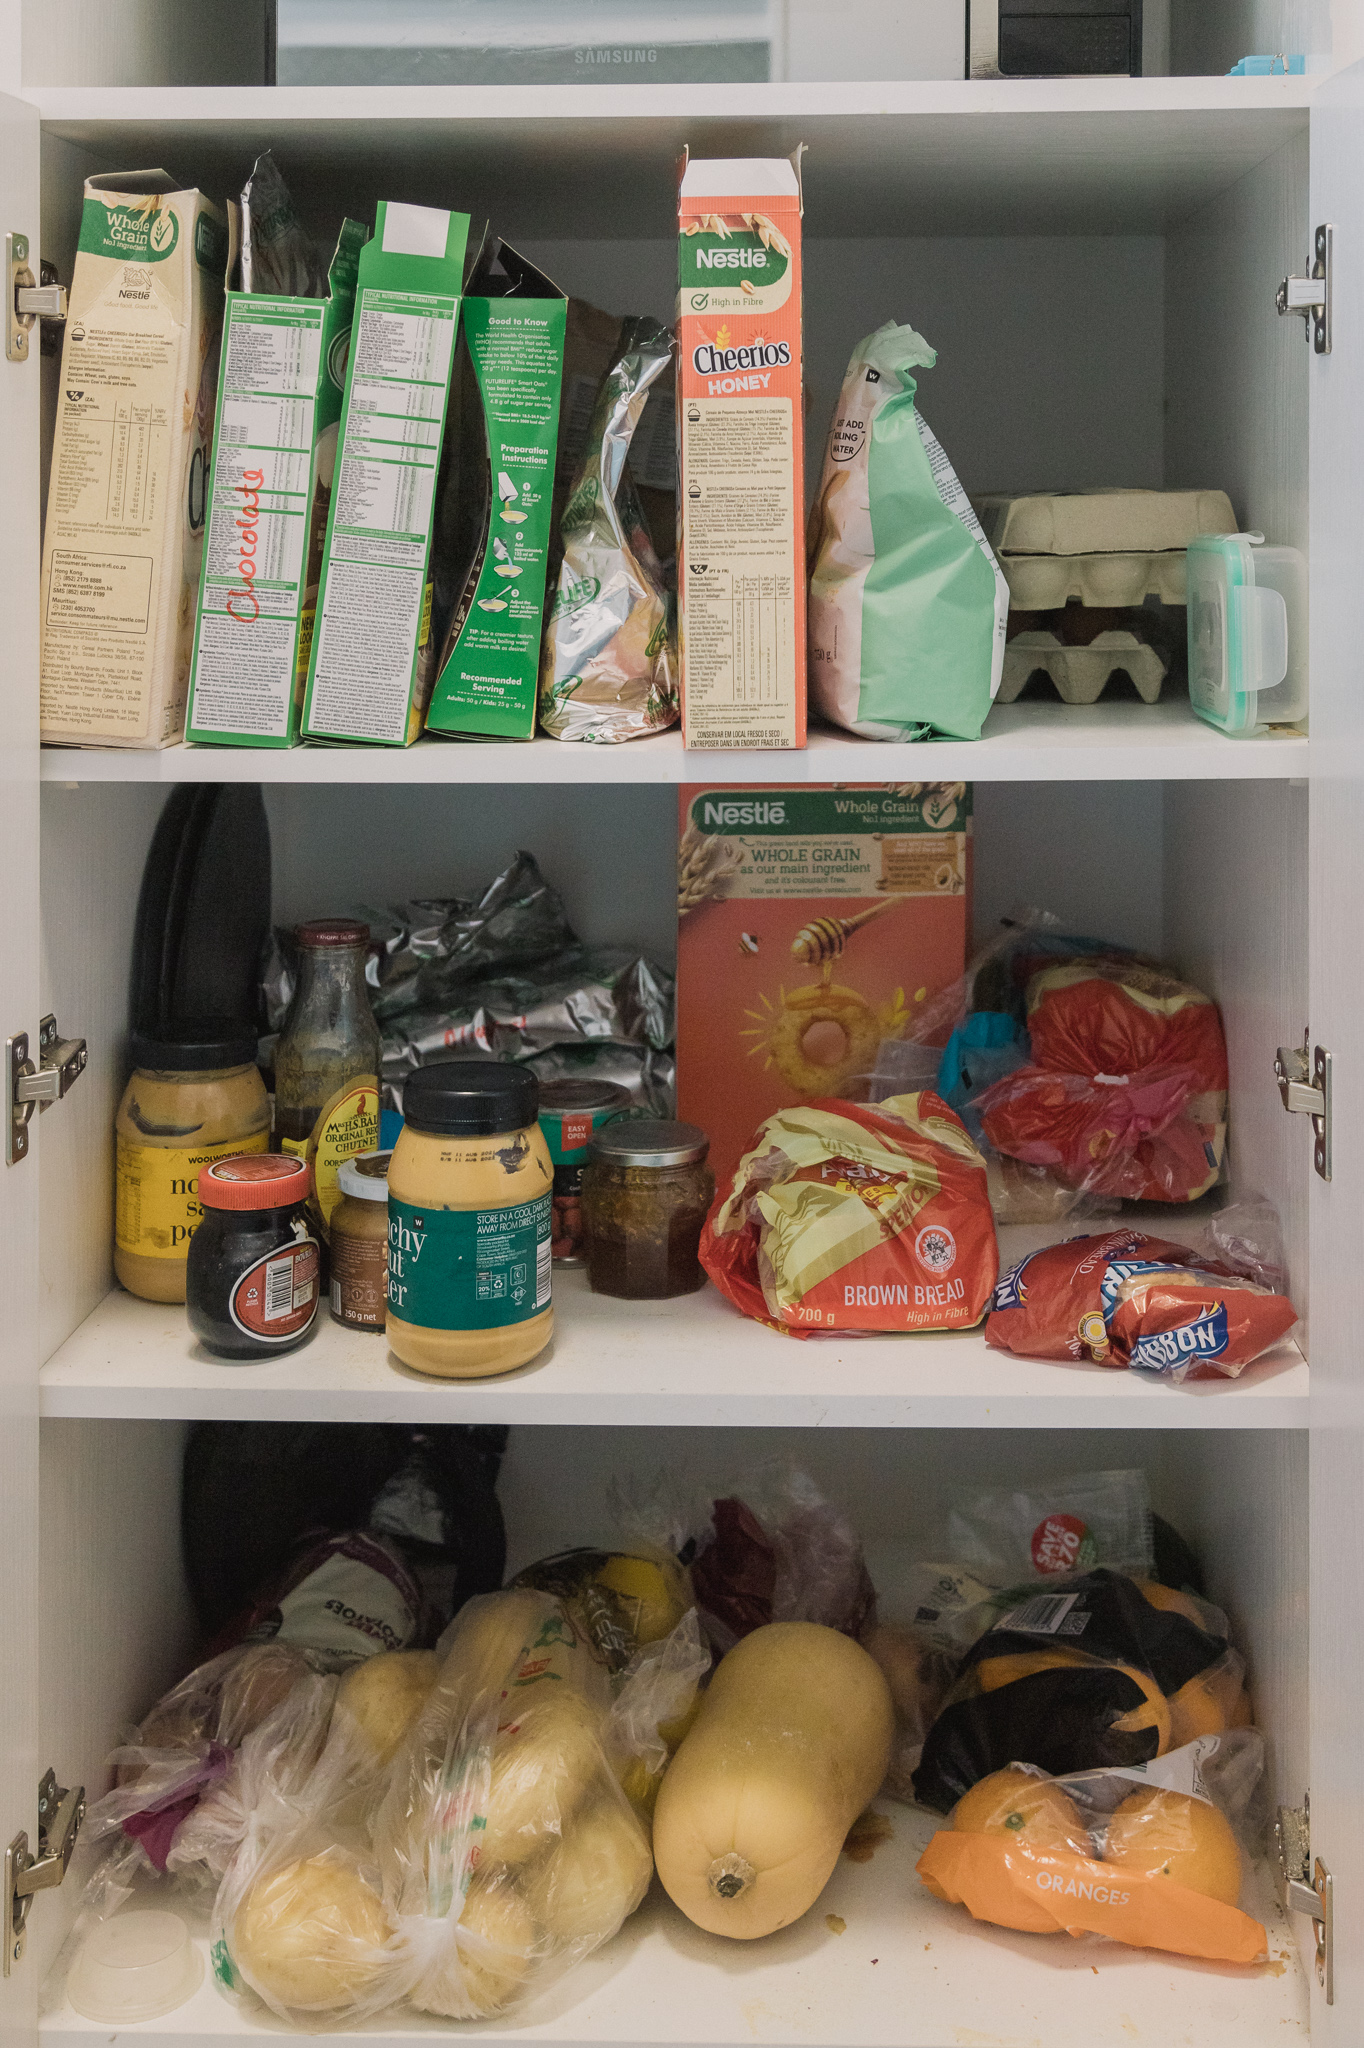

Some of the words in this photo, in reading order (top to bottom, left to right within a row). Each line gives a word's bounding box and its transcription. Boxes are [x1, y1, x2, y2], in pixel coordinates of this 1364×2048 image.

[574, 49, 657, 64] SAMSUNG
[106, 211, 150, 233] Whole
[110, 226, 148, 245] Grain
[103, 237, 115, 246] No.1
[117, 240, 147, 251] ingredient
[696, 248, 767, 269] Nestlé
[118, 289, 150, 300] Nestlé
[382, 293, 408, 302] NUTRITIONAL
[409, 295, 438, 305] INFORMATION
[249, 304, 276, 312] NUTRITIONAL
[277, 306, 305, 314] INFORMATION
[711, 298, 731, 308] High
[732, 298, 741, 306] in
[743, 298, 764, 306] Fibre
[488, 317, 512, 326] Good
[513, 318, 522, 326] to
[524, 318, 548, 327] Know
[518, 333, 550, 341] Organisation
[693, 339, 792, 376] Cheerios
[708, 373, 771, 396] HONEY
[845, 419, 864, 430] ADD
[500, 443, 549, 456] Preparation
[501, 453, 548, 465] Instructions
[226, 468, 265, 622] Chocolate
[56, 552, 72, 560] South
[72, 553, 88, 561] Africa:
[54, 568, 68, 576] Hong
[69, 568, 84, 577] Kong:
[52, 587, 65, 595] SMS
[66, 588, 79, 596] (852)
[79, 589, 93, 597] 6387
[93, 590, 105, 598] 8199
[62, 582, 113, 592] www.nestle.com.hk
[51, 596, 77, 605] Mauritius:
[74, 605, 95, 613] 4053700
[461, 672, 522, 685] Recommended
[473, 683, 504, 694] Serving
[696, 730, 724, 739] CONSERVAR
[724, 730, 731, 738] EM
[732, 729, 747, 738] LOCAL
[747, 729, 764, 738] FRESCO
[768, 729, 780, 738] SECO
[690, 739, 719, 748] ENTREPOSER
[719, 739, 733, 748] DANS
[733, 739, 740, 748] UN
[740, 739, 760, 748] ENDROIT
[760, 738, 773, 747] FRAIS
[780, 738, 789, 747] SEC
[704, 801, 786, 826] Nestlé
[834, 800, 879, 813] Whole
[882, 799, 920, 813] Grain
[862, 815, 879, 824] No.1
[880, 815, 920, 825] ingredient
[751, 849, 808, 863] WHOLE
[812, 848, 860, 862] GRAIN
[740, 866, 753, 874] as
[755, 865, 777, 874] our
[780, 864, 809, 873] main
[812, 863, 871, 876] ingredient
[764, 876, 778, 884] and
[792, 876, 828, 884] colourant
[325, 1129, 364, 1143] ORIGINAL
[476, 1214, 499, 1225] STORE
[500, 1213, 508, 1222] IN
[533, 1202, 544, 1215] DARK
[476, 1224, 499, 1235] AWAY
[499, 1220, 518, 1232] FROM
[518, 1214, 537, 1228] DIRECT
[538, 1224, 548, 1236] 800
[844, 1284, 908, 1307] BROWN
[915, 1278, 965, 1306] BREAD
[357, 1311, 362, 1322] g
[363, 1312, 377, 1321] net
[798, 1307, 822, 1322] 700
[827, 1312, 835, 1326] g
[906, 1310, 929, 1323] High
[932, 1311, 942, 1322] in
[945, 1306, 969, 1319] Fibre
[1036, 1871, 1130, 1906] ORANGES
